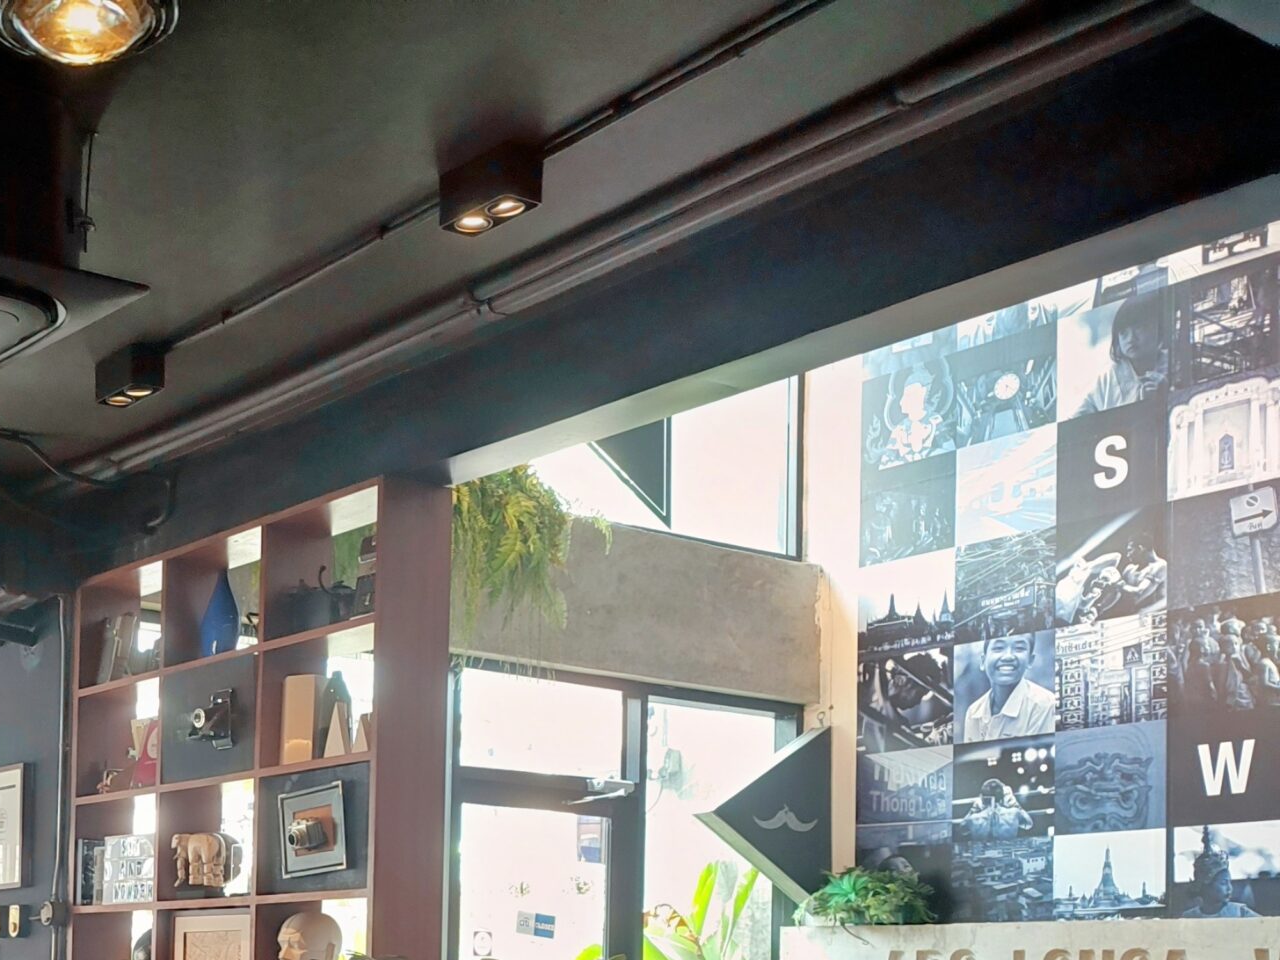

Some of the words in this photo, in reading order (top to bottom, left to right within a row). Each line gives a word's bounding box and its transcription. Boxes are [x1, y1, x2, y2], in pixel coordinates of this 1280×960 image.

[1092, 434, 1129, 489] S
[1197, 738, 1256, 797] W
[869, 790, 916, 817] Thong
